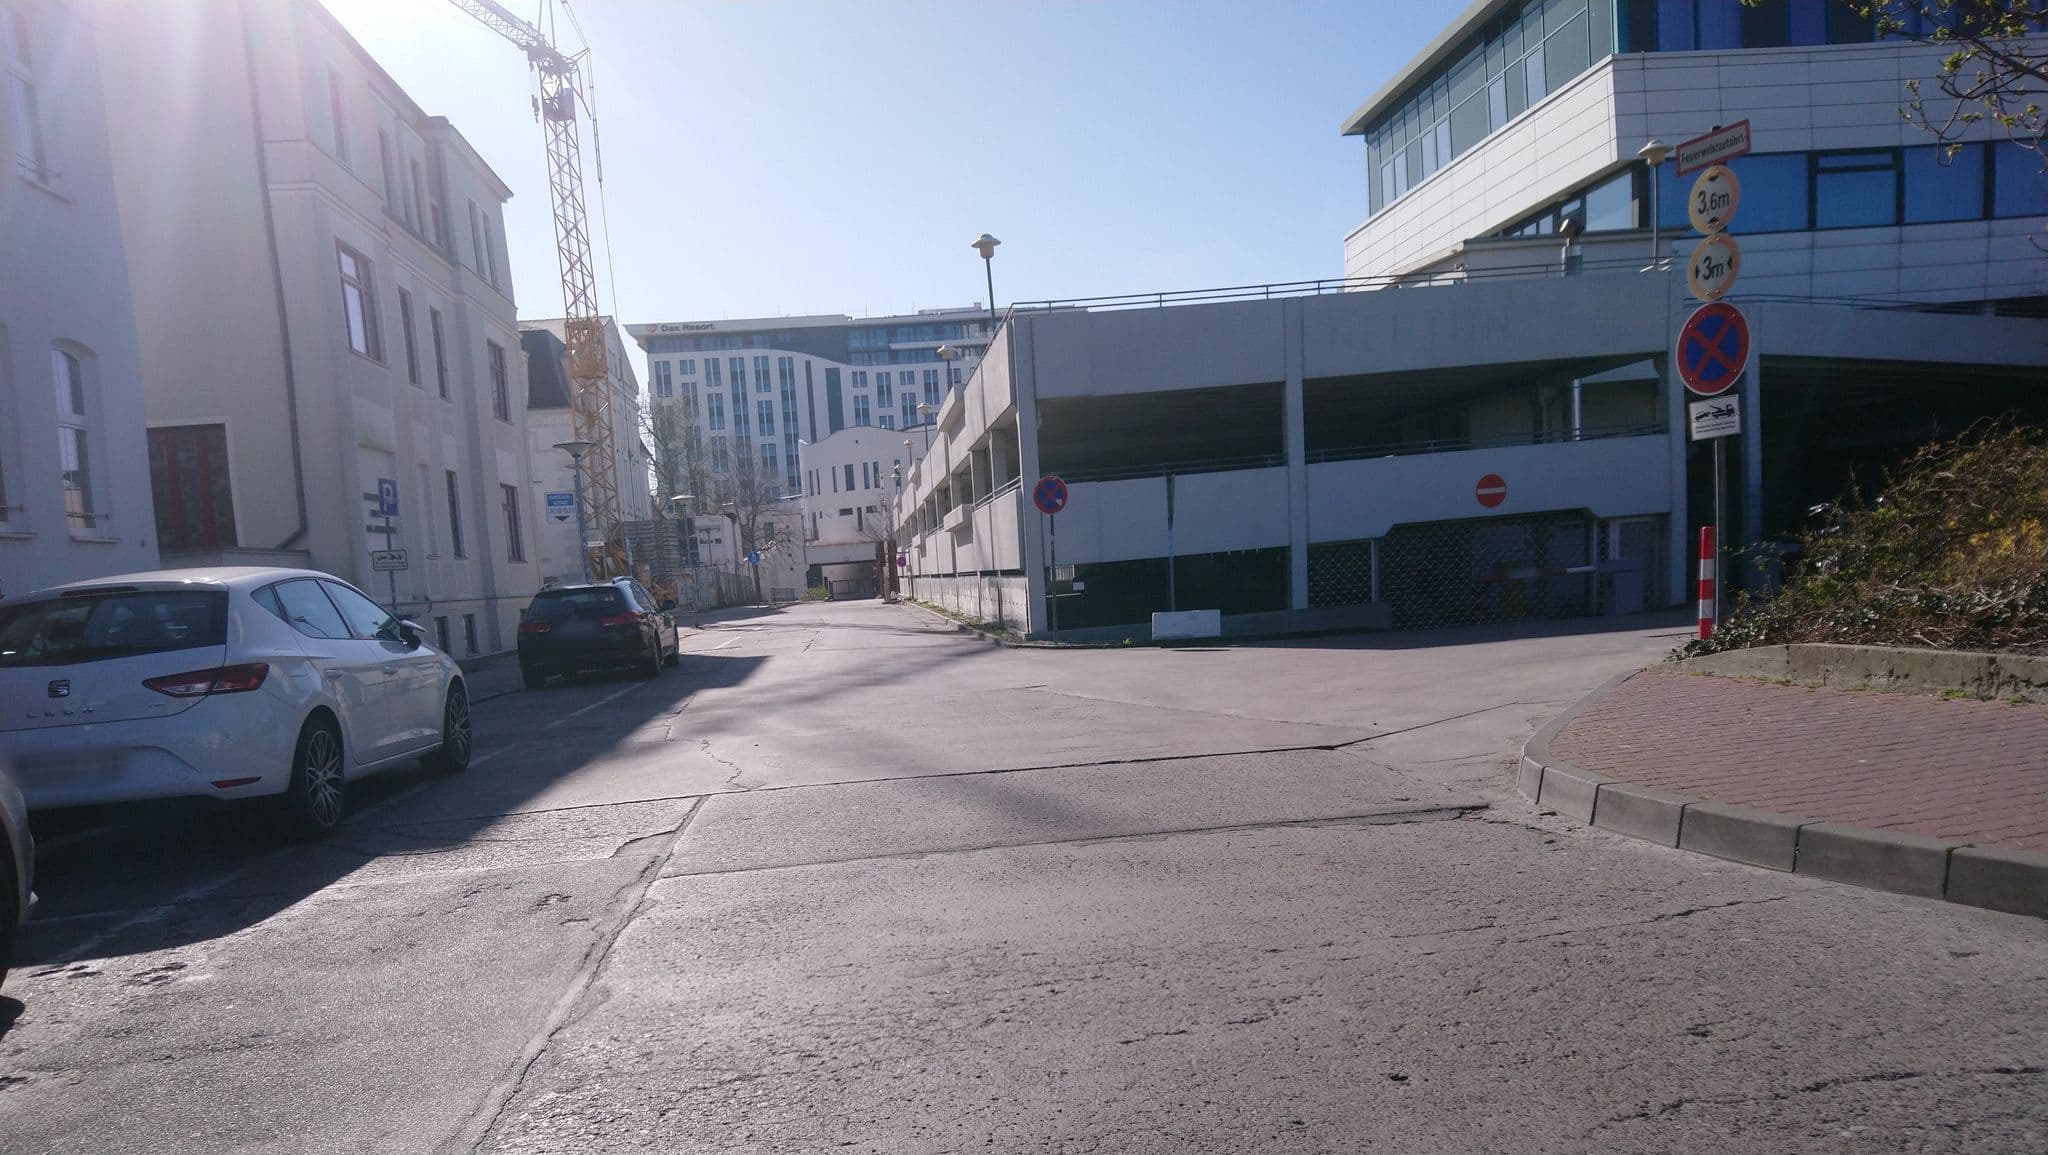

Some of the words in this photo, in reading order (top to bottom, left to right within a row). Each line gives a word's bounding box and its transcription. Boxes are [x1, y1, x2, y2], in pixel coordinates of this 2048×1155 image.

[1681, 132, 1745, 164] Feuerwehrzufahrt
[1697, 190, 1730, 216] 3,6m
[1702, 255, 1724, 281] 3m
[661, 324, 680, 332] Das
[683, 322, 715, 331] Resort
